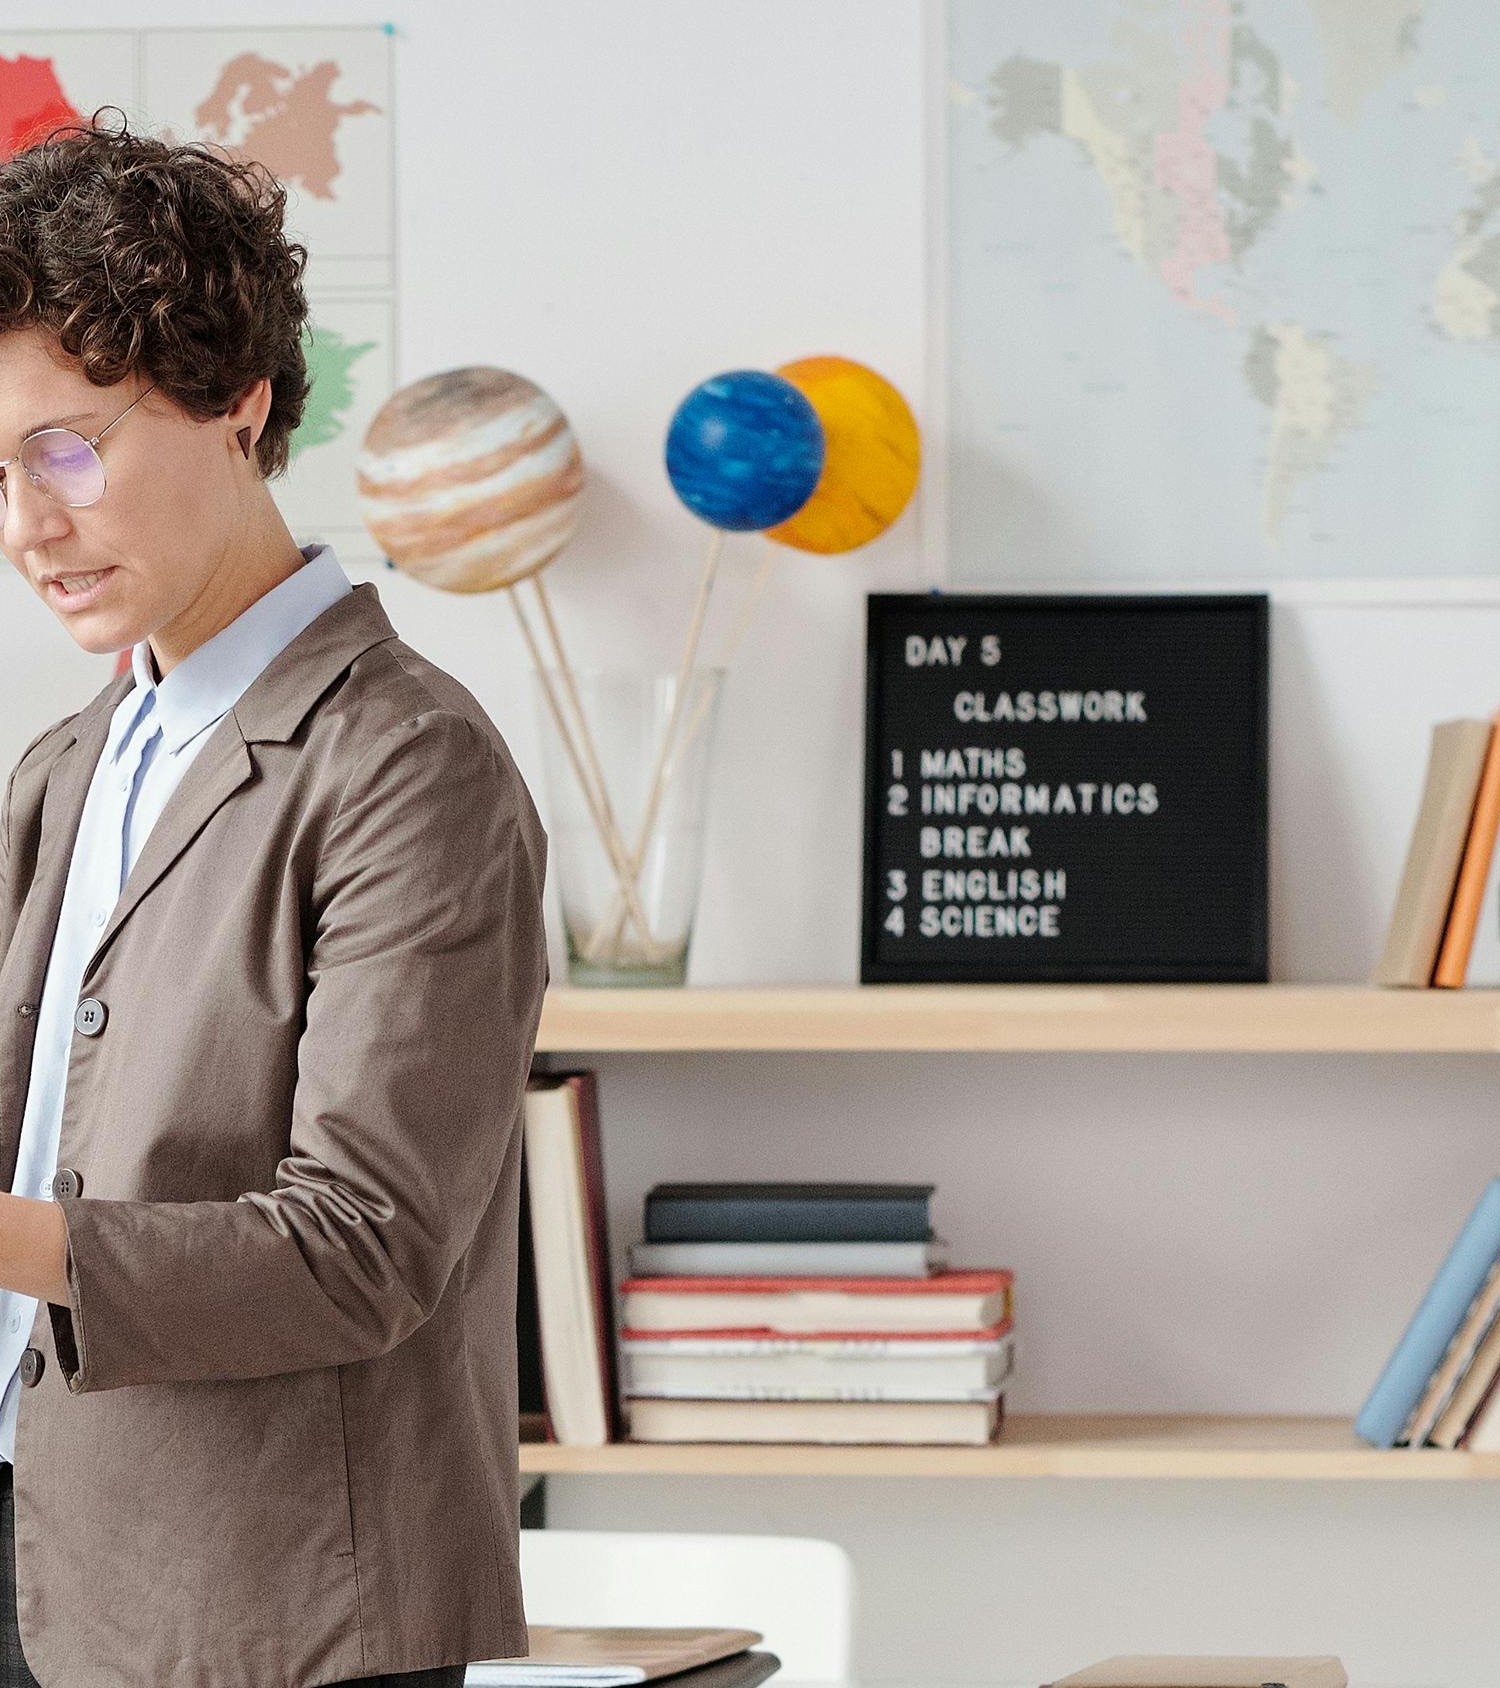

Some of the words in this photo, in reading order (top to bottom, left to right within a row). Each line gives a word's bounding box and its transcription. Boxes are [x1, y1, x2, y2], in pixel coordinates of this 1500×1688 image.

[905, 635, 968, 667] DAY
[981, 635, 1001, 666] 5
[953, 690, 1148, 723] CLASSWORK
[891, 749, 903, 779] 1
[920, 747, 1027, 779] MATHS
[887, 783, 909, 816] 2
[921, 782, 1160, 816] INFORMATICS
[919, 826, 1032, 859] BREAK
[886, 869, 908, 902] 3
[922, 869, 1067, 902] ENGLISH
[884, 906, 906, 938] 4
[919, 905, 1061, 938] SCIENCE
